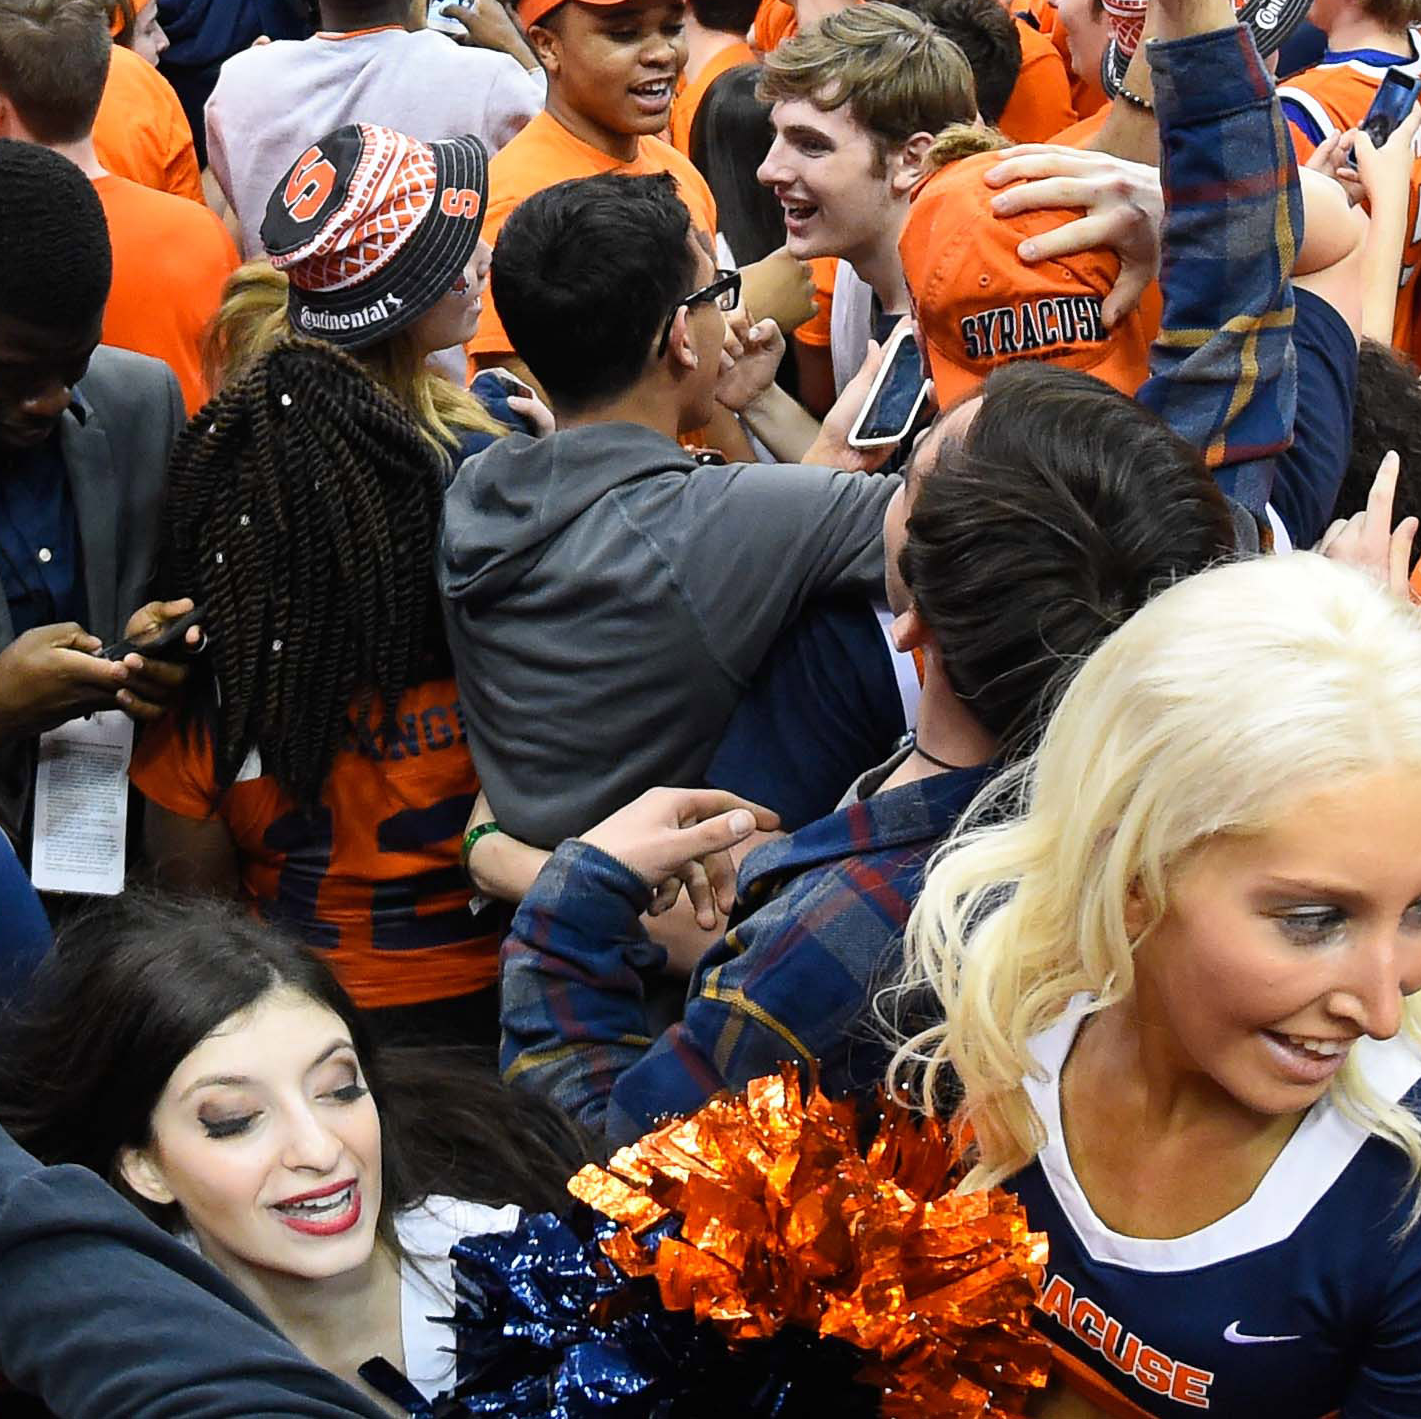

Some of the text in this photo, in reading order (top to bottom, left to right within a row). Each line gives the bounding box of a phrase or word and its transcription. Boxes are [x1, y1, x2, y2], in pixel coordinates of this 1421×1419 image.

[283, 145, 337, 223] S
[440, 187, 481, 220] S
[1031, 1274, 1214, 1409] ACUSE
